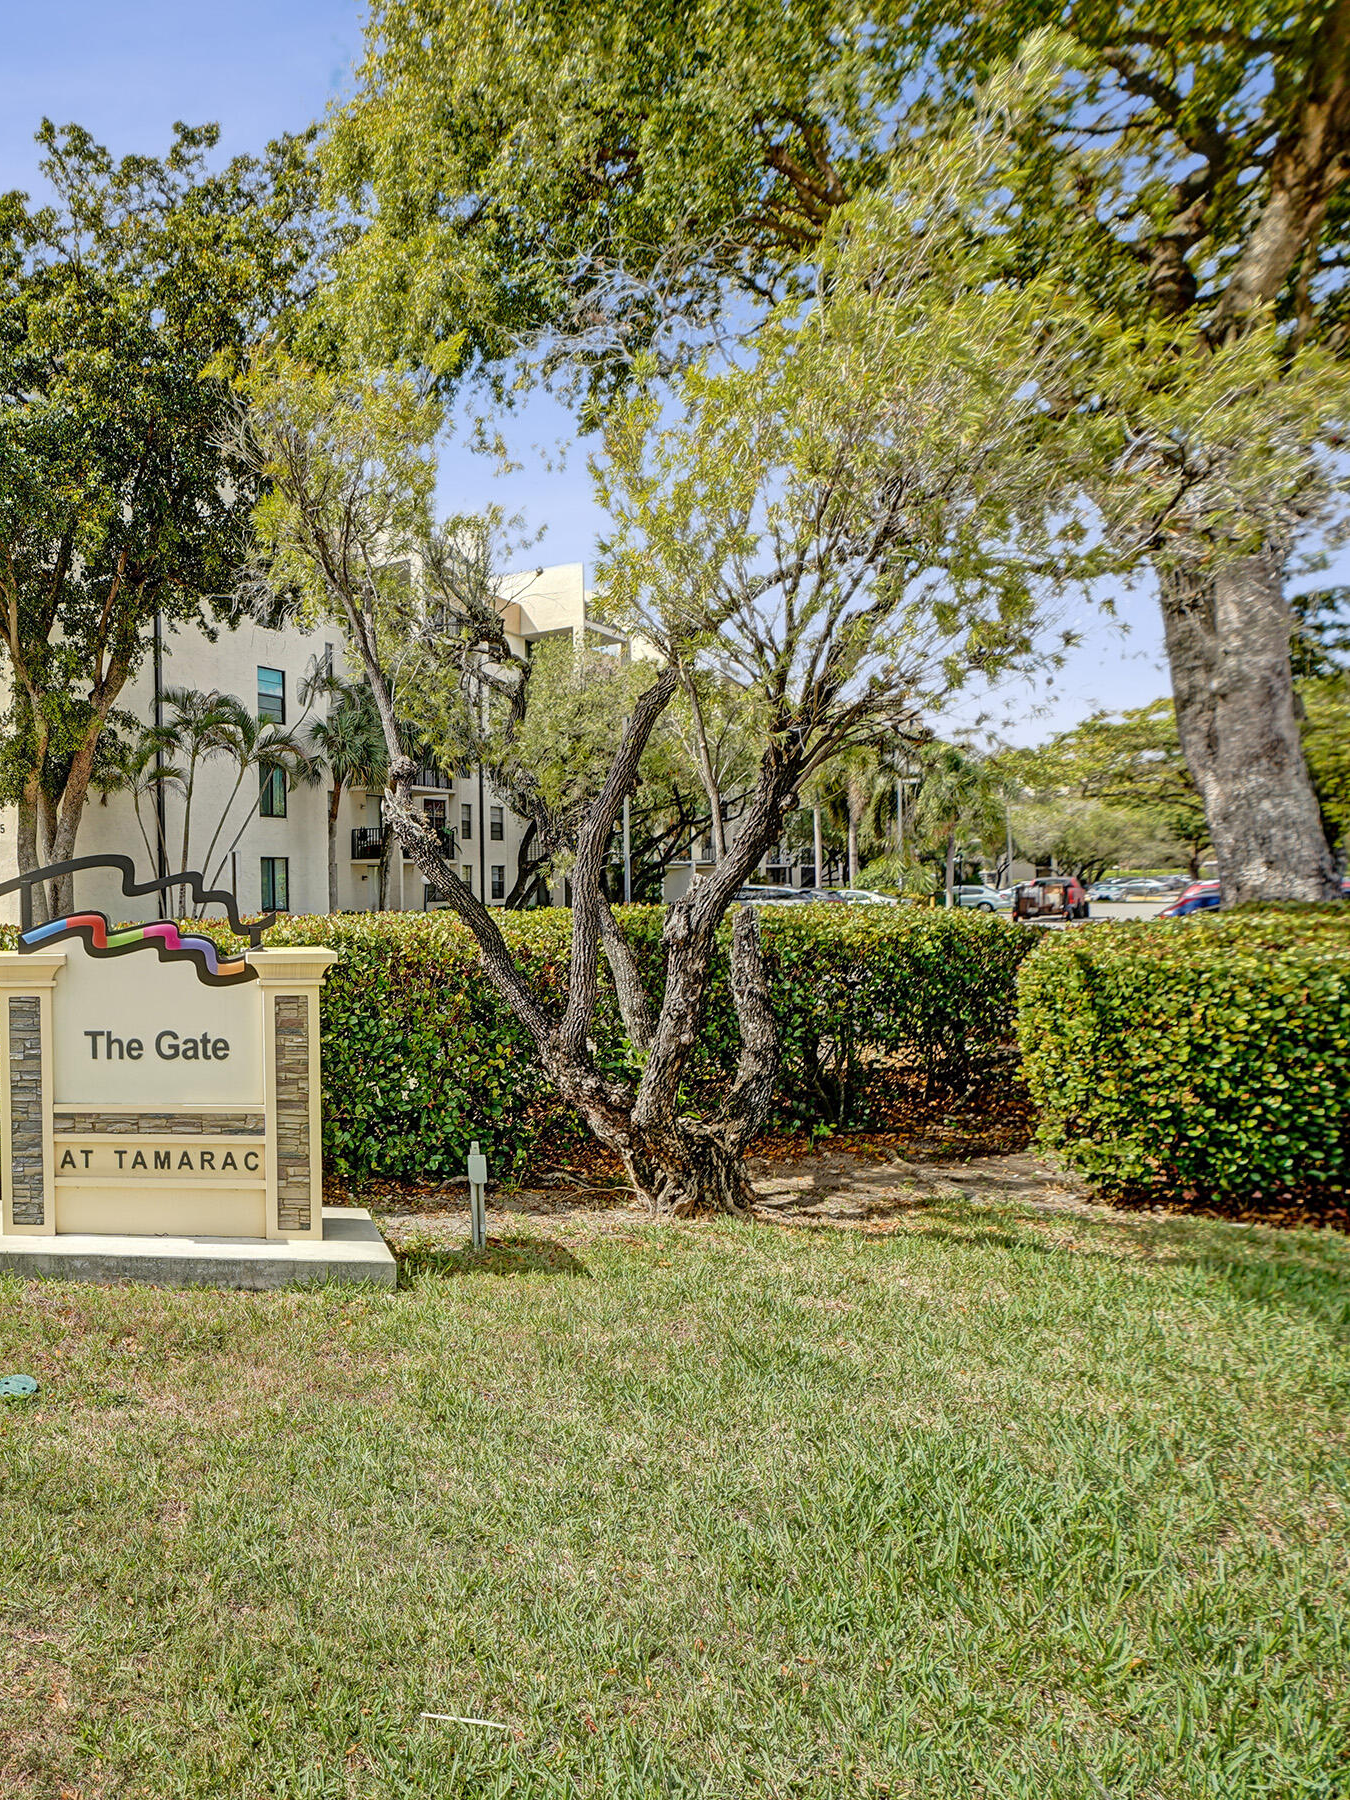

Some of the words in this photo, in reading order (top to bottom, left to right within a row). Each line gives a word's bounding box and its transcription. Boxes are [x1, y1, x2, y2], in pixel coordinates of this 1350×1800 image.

[83, 1030, 144, 1060] The
[155, 1030, 230, 1061] Gate
[60, 1150, 94, 1169] AT
[114, 1150, 260, 1171] TAMARAC
